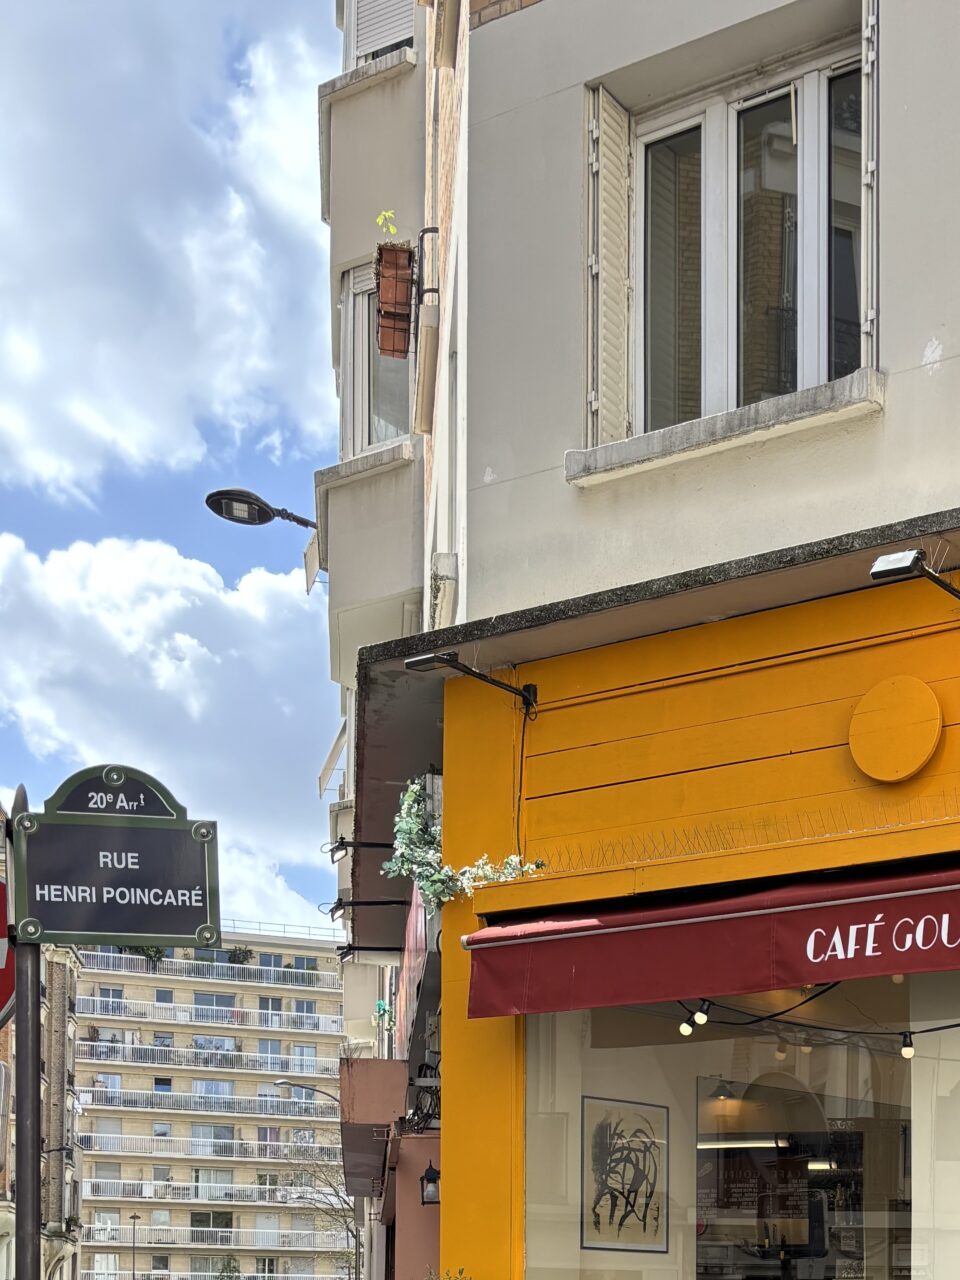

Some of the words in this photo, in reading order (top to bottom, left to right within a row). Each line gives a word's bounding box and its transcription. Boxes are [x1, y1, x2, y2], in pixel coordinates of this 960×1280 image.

[99, 851, 139, 869] RUE
[35, 884, 96, 902] HENRI
[103, 886, 203, 906] POINCARÉ
[806, 914, 885, 962] CAFÉ
